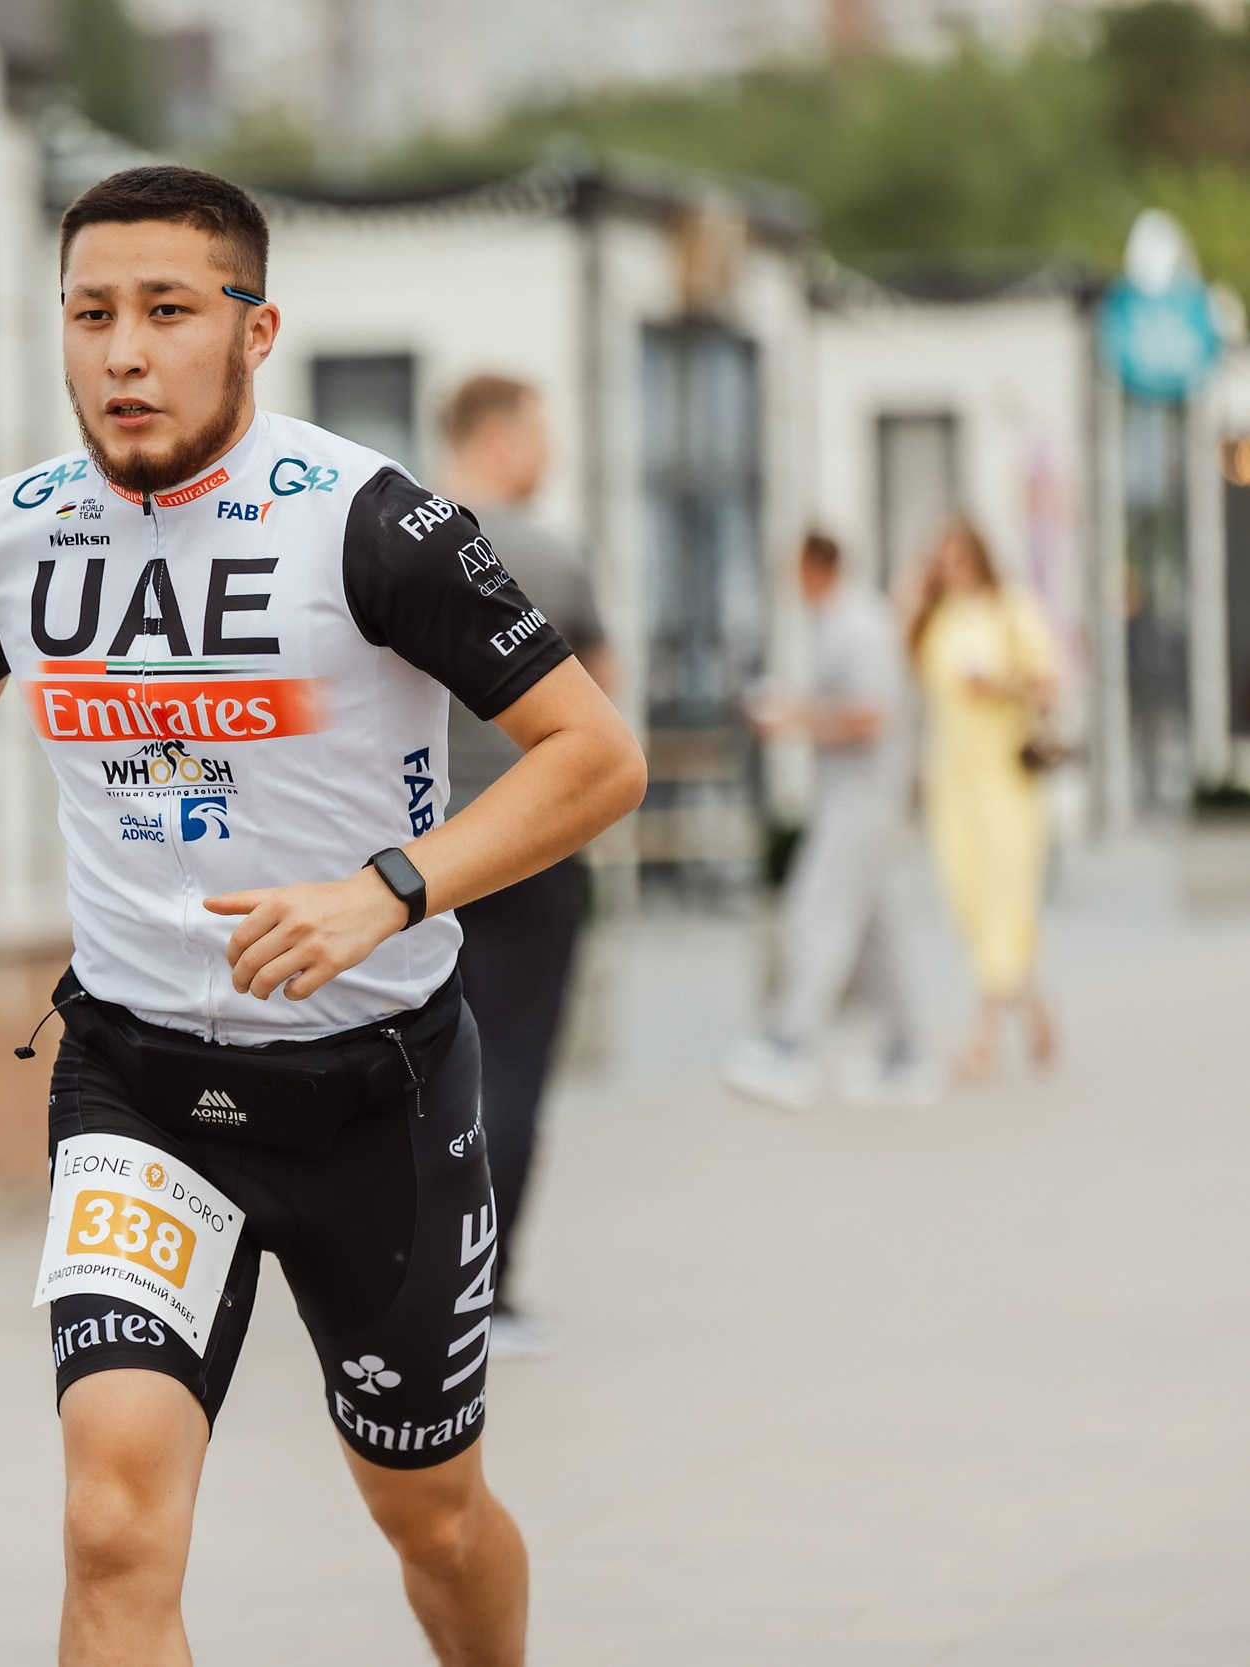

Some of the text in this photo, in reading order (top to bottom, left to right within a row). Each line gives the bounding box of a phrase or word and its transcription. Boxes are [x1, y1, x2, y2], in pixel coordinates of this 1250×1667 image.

[12, 459, 88, 509] G42
[156, 471, 228, 507] Emirates
[270, 457, 339, 497] G42
[79, 512, 101, 520] TEAM
[80, 504, 104, 512] WORLD
[49, 528, 110, 548] Welksn
[31, 557, 281, 657] UAE
[42, 688, 277, 737] Emirates
[101, 757, 234, 785] WHOOSH
[106, 787, 239, 798] Virtual Cycling Solution
[121, 828, 165, 843] ADNOC
[191, 1108, 248, 1122] AONIJIE
[199, 1117, 240, 1126] RUNNING
[64, 1155, 224, 1233] LEONE D'ORO
[78, 1197, 183, 1272] 338
[48, 1263, 196, 1325] БЛАГОТВОРИТЕЛЬНЫЙ ЗАБЕГ
[442, 1186, 498, 1393] UAE
